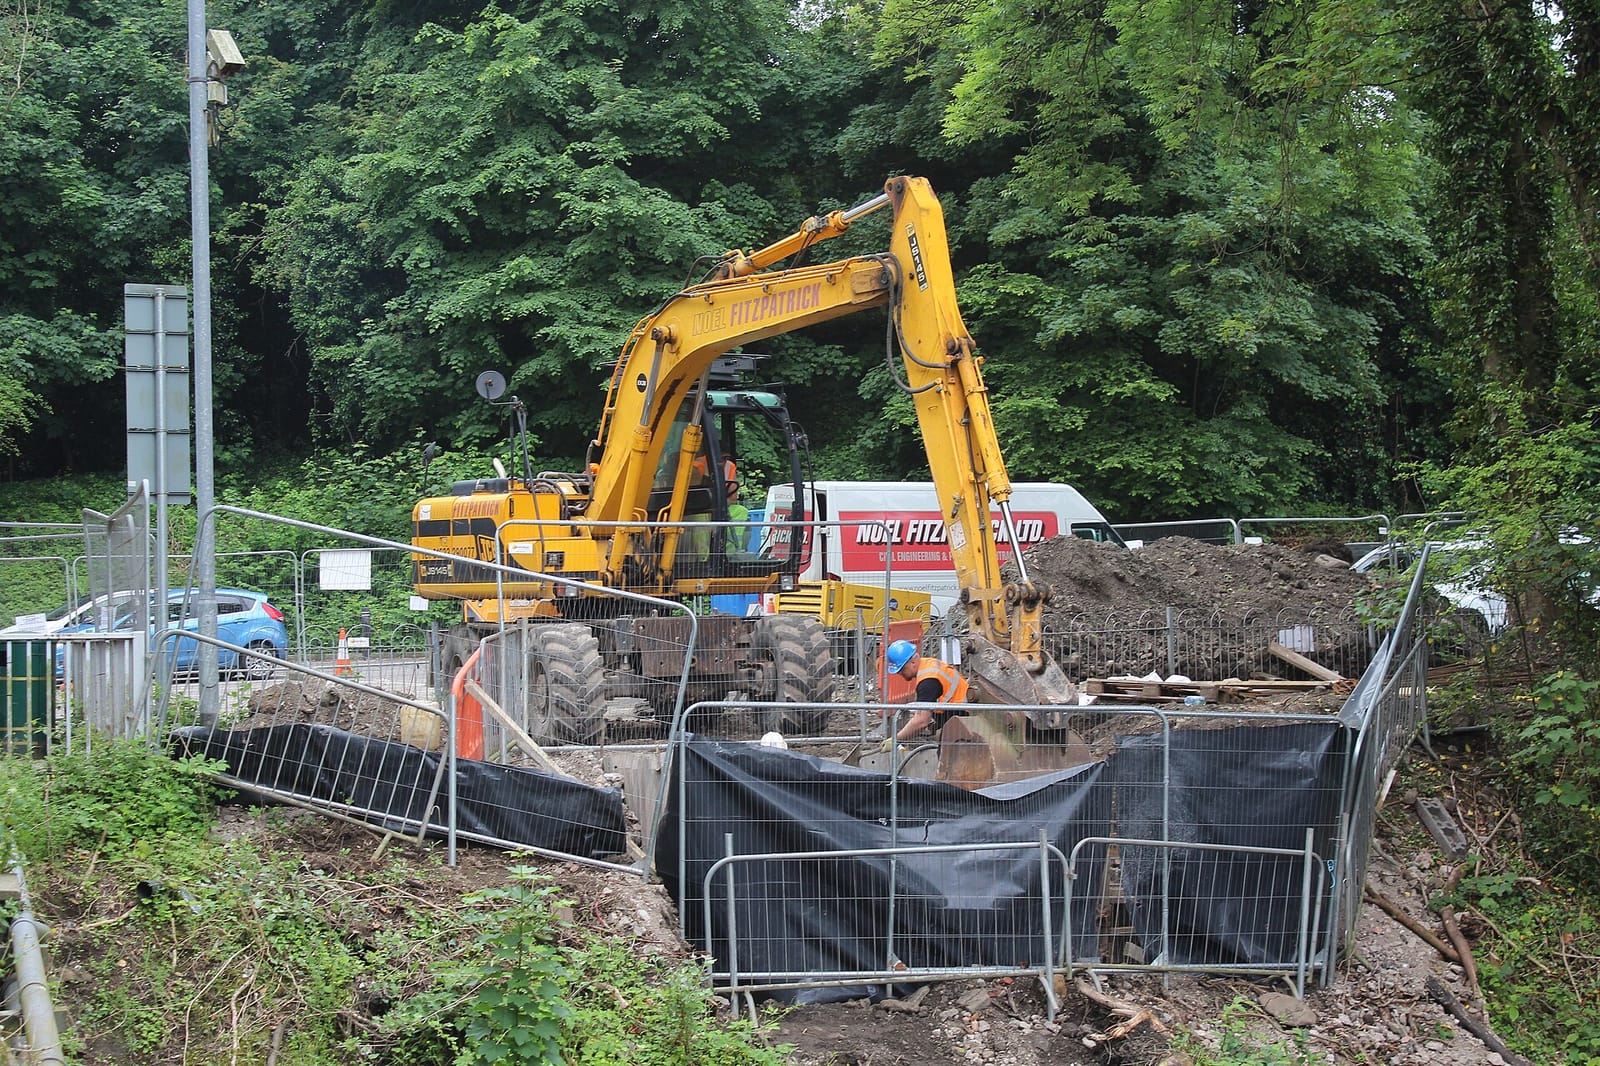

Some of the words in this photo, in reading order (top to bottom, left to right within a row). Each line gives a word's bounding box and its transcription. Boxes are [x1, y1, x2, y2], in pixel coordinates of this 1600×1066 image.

[910, 236, 925, 283] JS145
[692, 306, 726, 337] NOEL
[729, 283, 822, 327] FITZPATRICK
[453, 500, 499, 518] FITZPATRICK
[856, 519, 902, 543] NOEL
[897, 551, 941, 562] ENGINEERING
